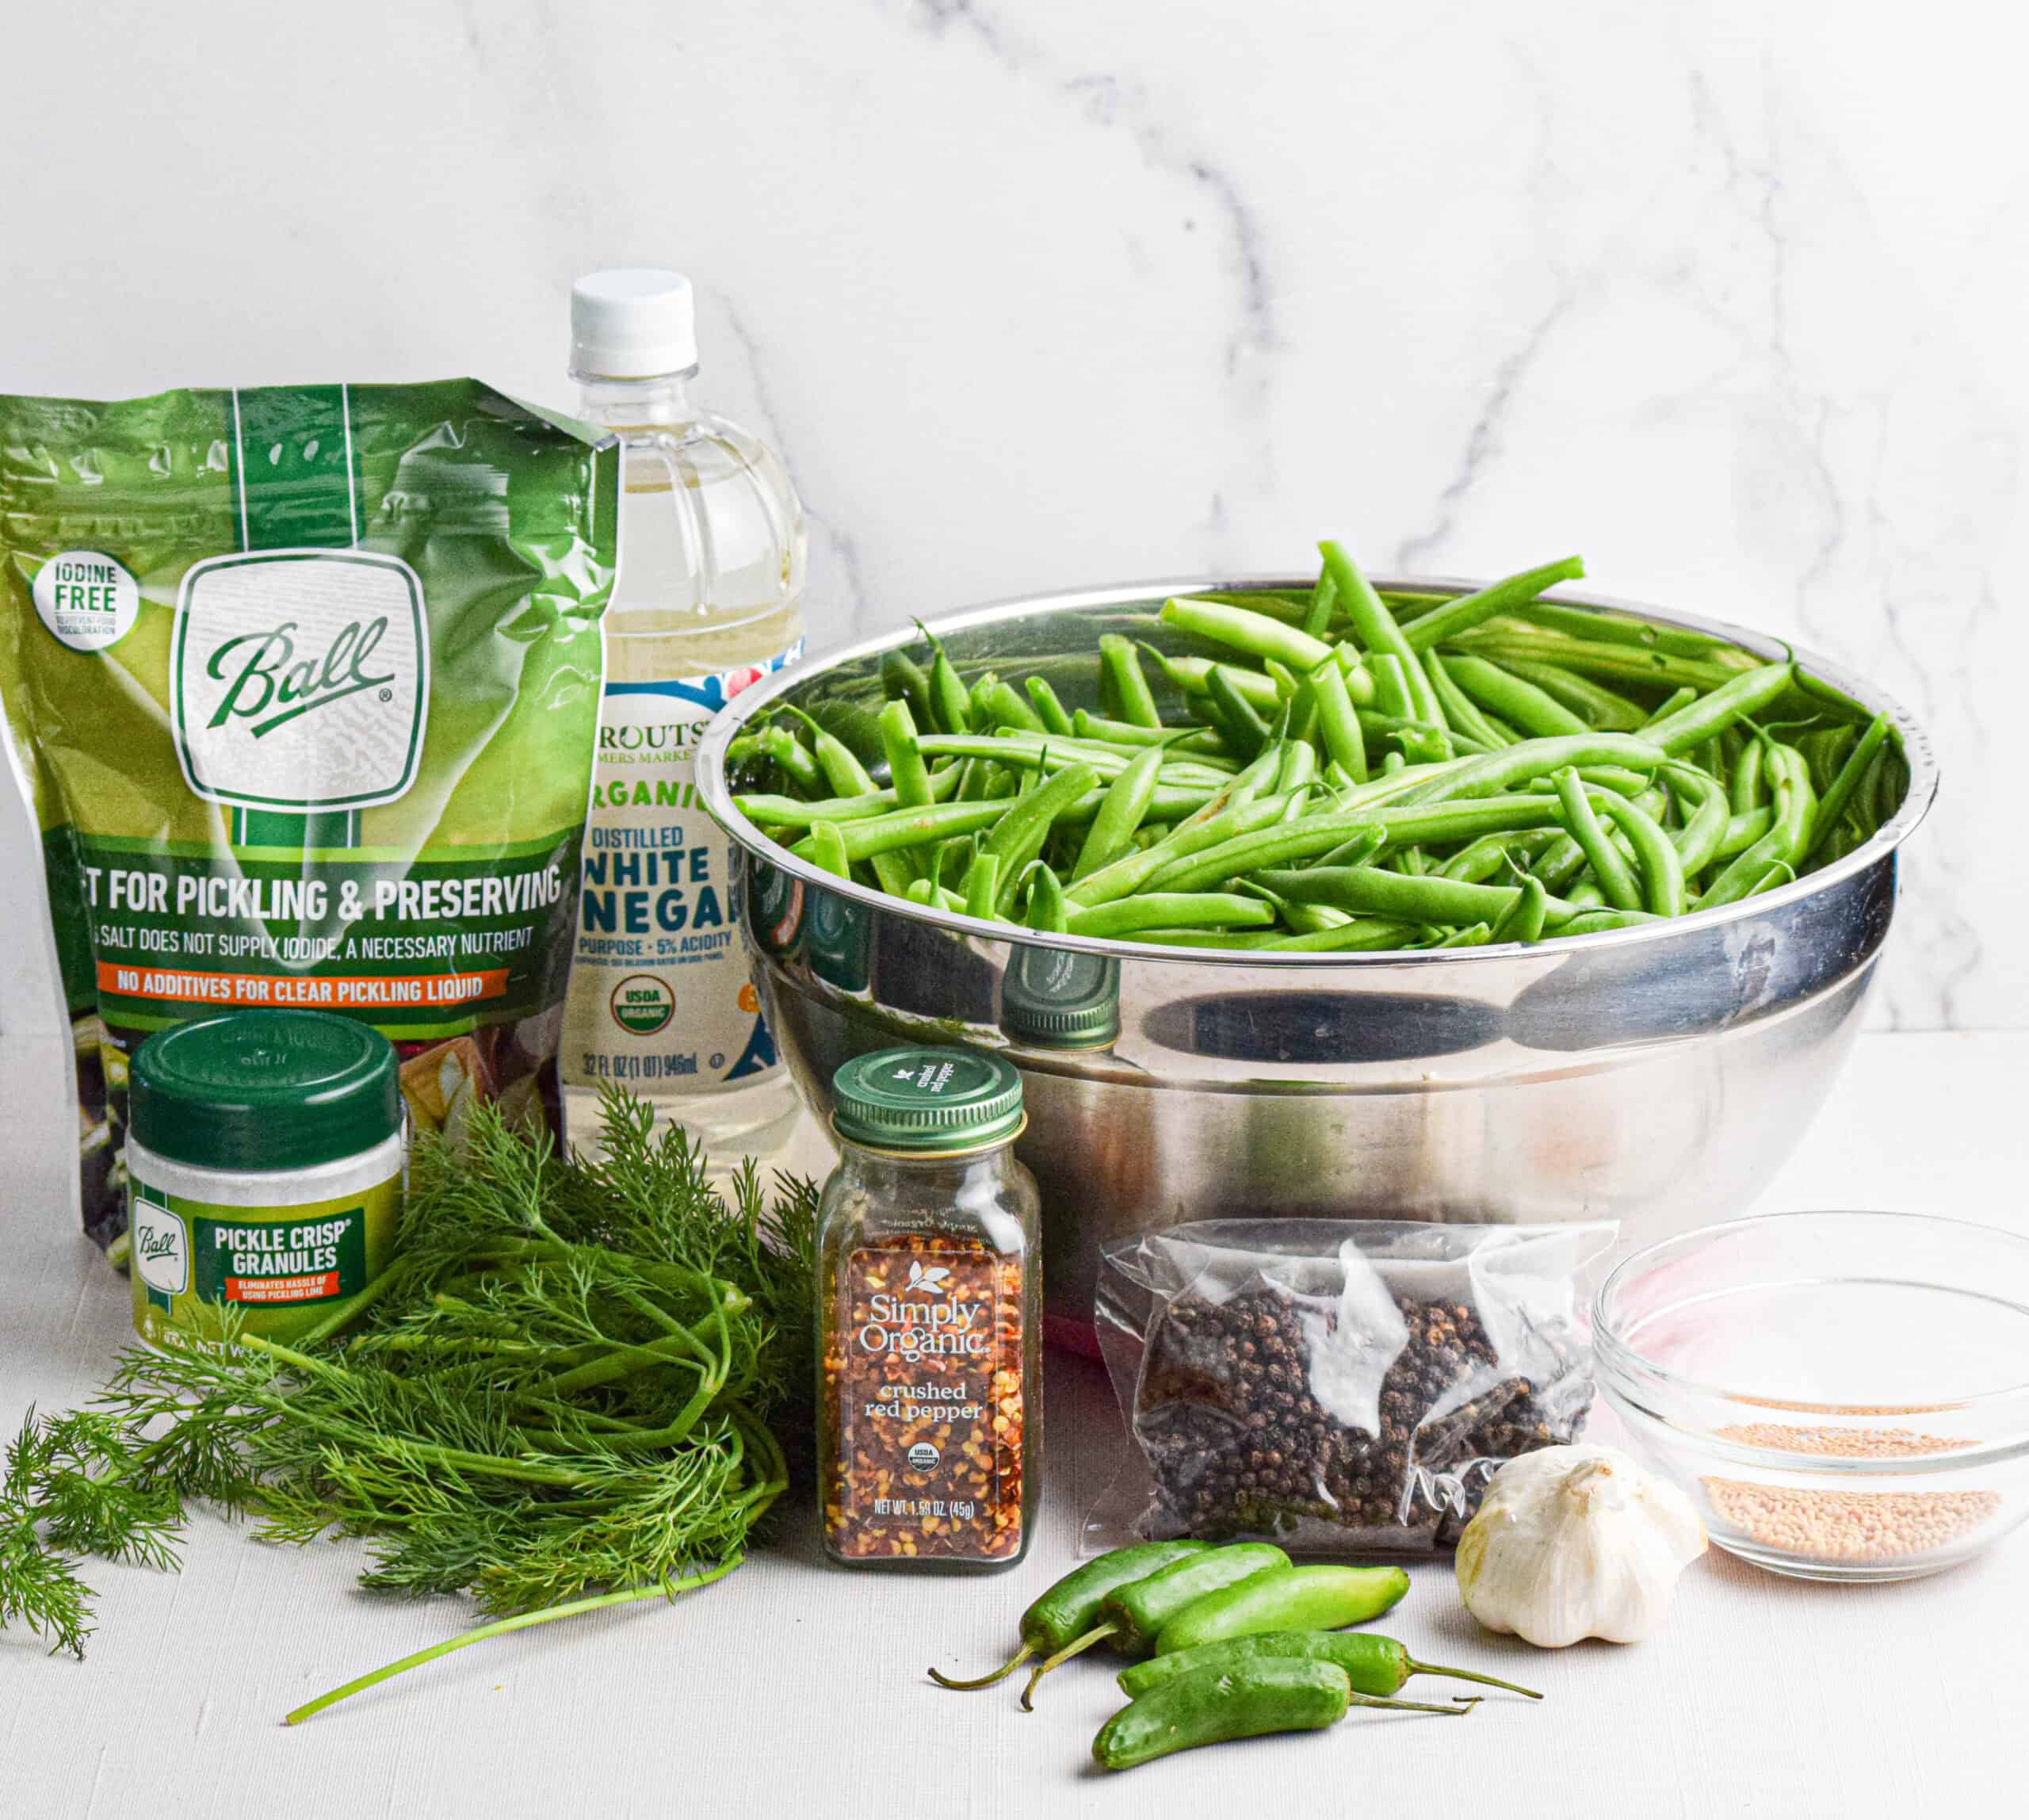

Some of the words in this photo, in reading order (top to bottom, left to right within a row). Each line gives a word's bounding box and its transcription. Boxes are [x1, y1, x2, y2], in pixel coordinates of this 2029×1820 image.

[55, 562, 117, 583] IODINE
[55, 584, 117, 612] FREE
[205, 617, 395, 740] Ball
[591, 826, 683, 848] DISTILLED
[583, 847, 709, 886] WHITE
[109, 870, 168, 913] FOR
[177, 875, 328, 921] PICKLING
[338, 879, 364, 920] &
[374, 865, 562, 920] PRESERVING
[101, 925, 135, 949] SALT
[139, 928, 179, 952] DOES
[183, 932, 215, 954] NOT
[219, 935, 279, 958] SUPPLY
[283, 937, 341, 961] IODIDE,
[346, 941, 357, 958] A
[361, 934, 457, 959] NECESSARY
[461, 926, 534, 955] NUTRIENT
[579, 937, 643, 955] PURPOSE
[657, 938, 676, 954] 5%
[681, 931, 732, 951] ACIDITY
[117, 969, 139, 991] NO
[143, 973, 231, 1000] ADDITIVES
[235, 978, 269, 1000] FOR
[274, 981, 332, 1003] CLEAR
[338, 981, 422, 1002] PICKLING
[427, 977, 483, 1001] LIQUID
[625, 990, 660, 1003] USDA
[621, 1007, 665, 1019] ORGANIC
[613, 1054, 627, 1077] OZ
[139, 1225, 178, 1262] Ball
[215, 1227, 285, 1252] PICKLE
[232, 1246, 338, 1275] GRANULES
[239, 1279, 285, 1290] ELIMINATES
[286, 1276, 315, 1288] HASSLE
[317, 1275, 327, 1285] OF
[243, 1290, 266, 1300] USING
[268, 1289, 304, 1300] PICKLING
[869, 1294, 982, 1334] Simply
[879, 1382, 967, 1400] crushed
[865, 1401, 900, 1417] red
[906, 1404, 984, 1423] pepper
[874, 1499, 889, 1515] NET
[950, 1500, 975, 1520] (45g)
